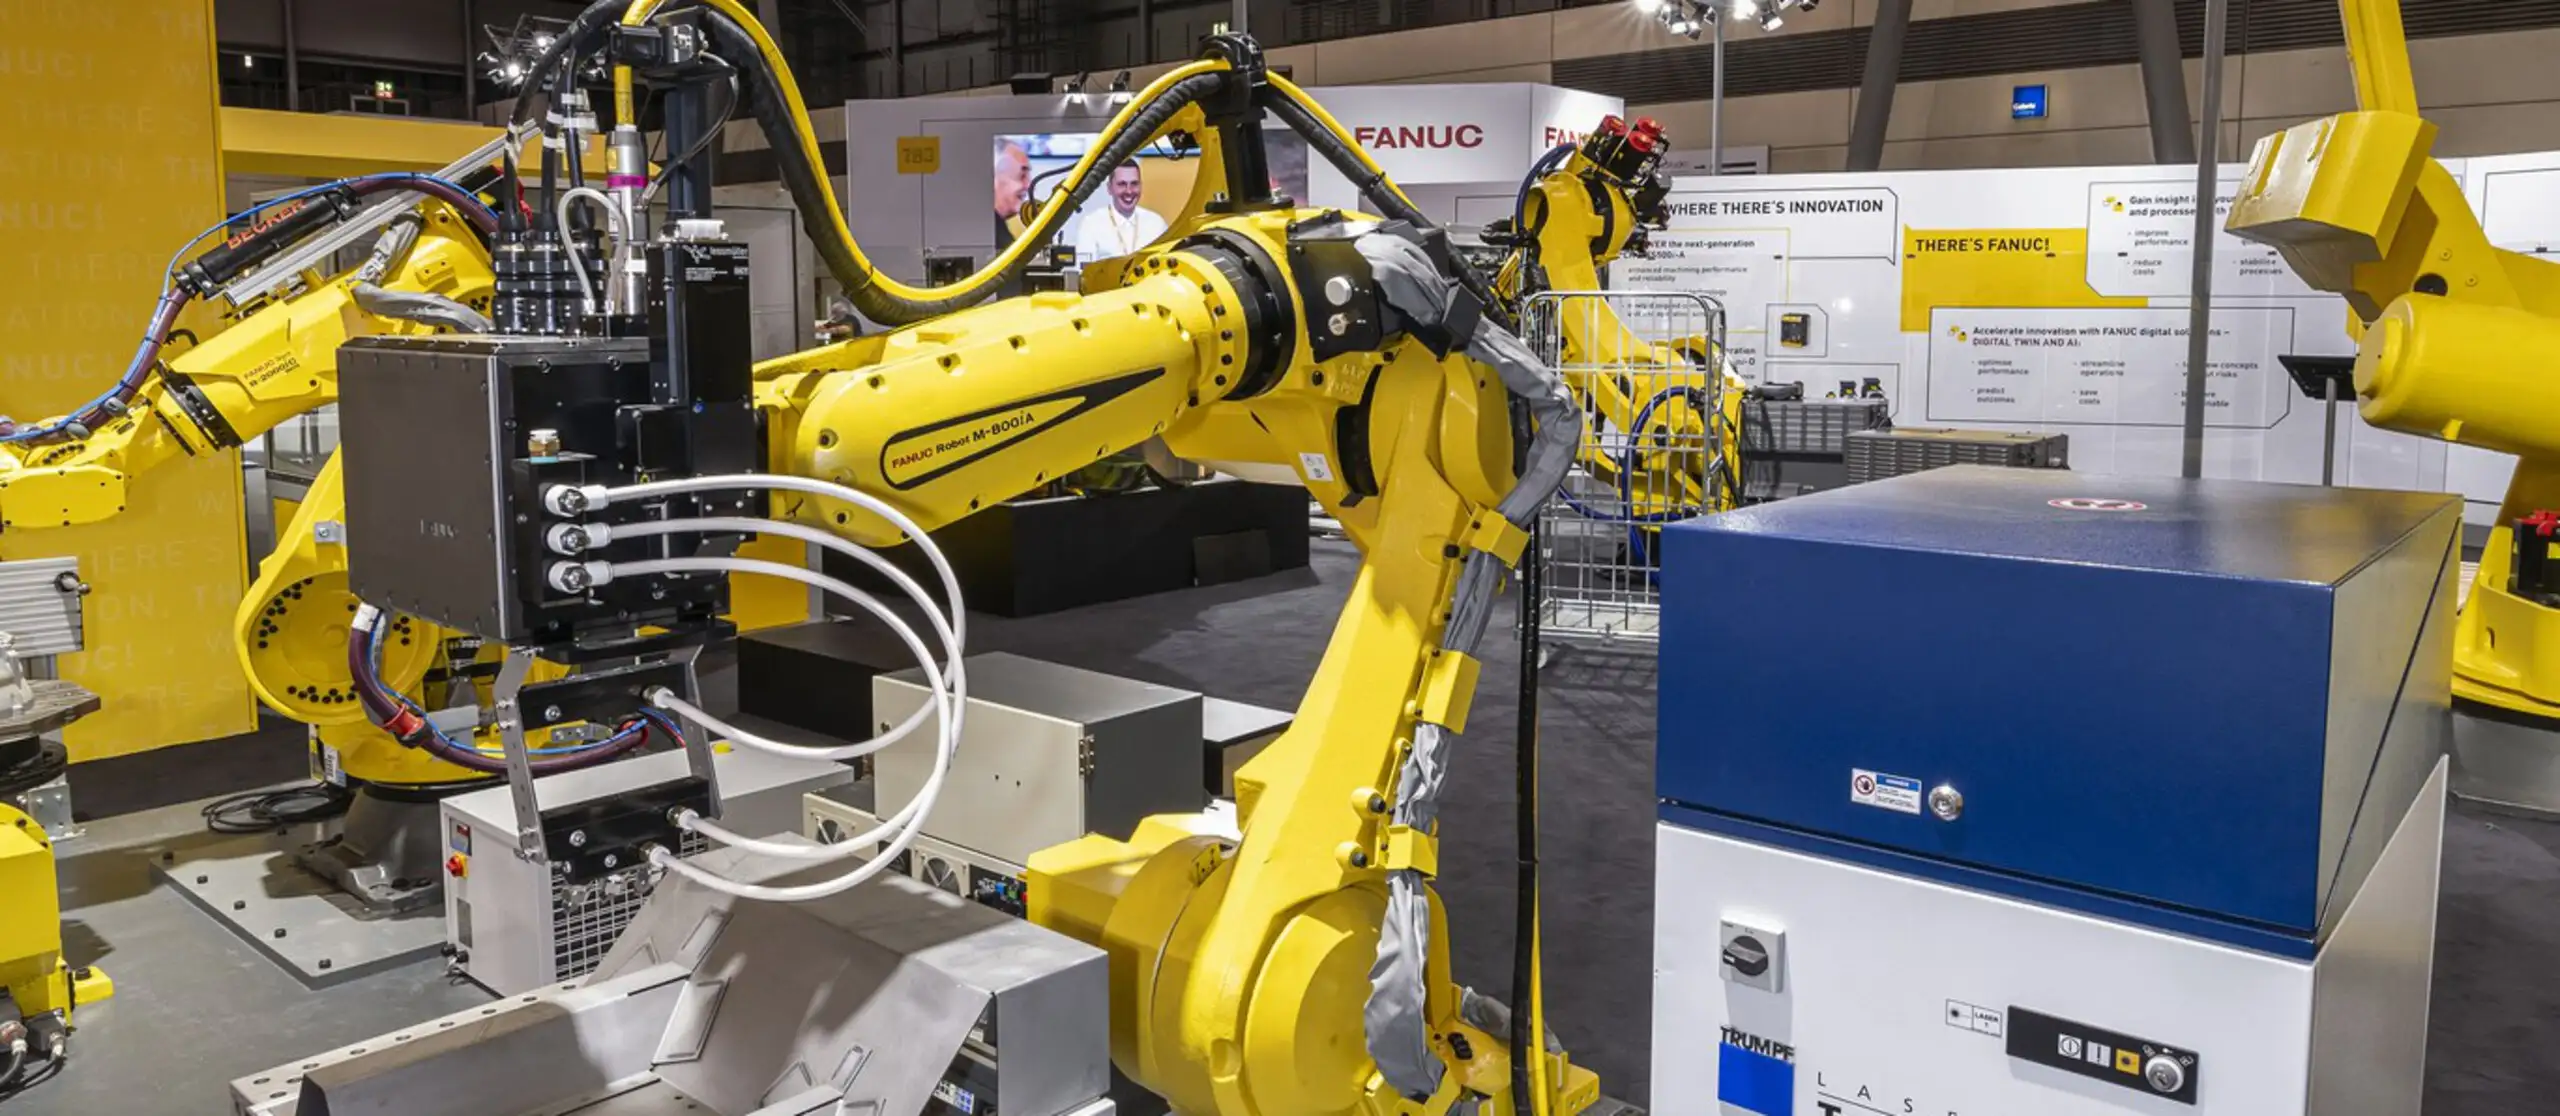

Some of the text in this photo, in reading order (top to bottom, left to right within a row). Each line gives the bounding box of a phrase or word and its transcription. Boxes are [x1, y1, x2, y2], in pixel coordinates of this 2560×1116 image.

[1355, 123, 1484, 149] FANUC
[2129, 195, 2153, 205] Gain
[2155, 195, 2190, 206] insight
[1722, 200, 1785, 214] THERE'S
[1789, 199, 1884, 213] INNOVATION
[2129, 207, 2148, 216] and
[2135, 230, 2169, 238] improve
[1684, 240, 1755, 250] next-generation
[1915, 238, 2050, 254] THERE'S FANUC!
[2134, 238, 2188, 247] performance
[2133, 259, 2162, 267] reduce
[1973, 326, 2024, 335] Accelerate
[2026, 326, 2077, 335] innovation
[2079, 326, 2101, 335] with
[2103, 326, 2137, 336] FANUC
[2139, 326, 2172, 338] digital
[1973, 338, 2011, 348] DIGITAL
[2014, 338, 2040, 348] TWIN
[2043, 338, 2064, 348] AND
[2220, 361, 2259, 370] concepts
[1977, 367, 2030, 377] performance
[891, 447, 933, 469] FANUC
[935, 436, 970, 455] Robot
[1720, 1025, 1796, 1062] TRUMPF
[1817, 1071, 1958, 1116] LAS
